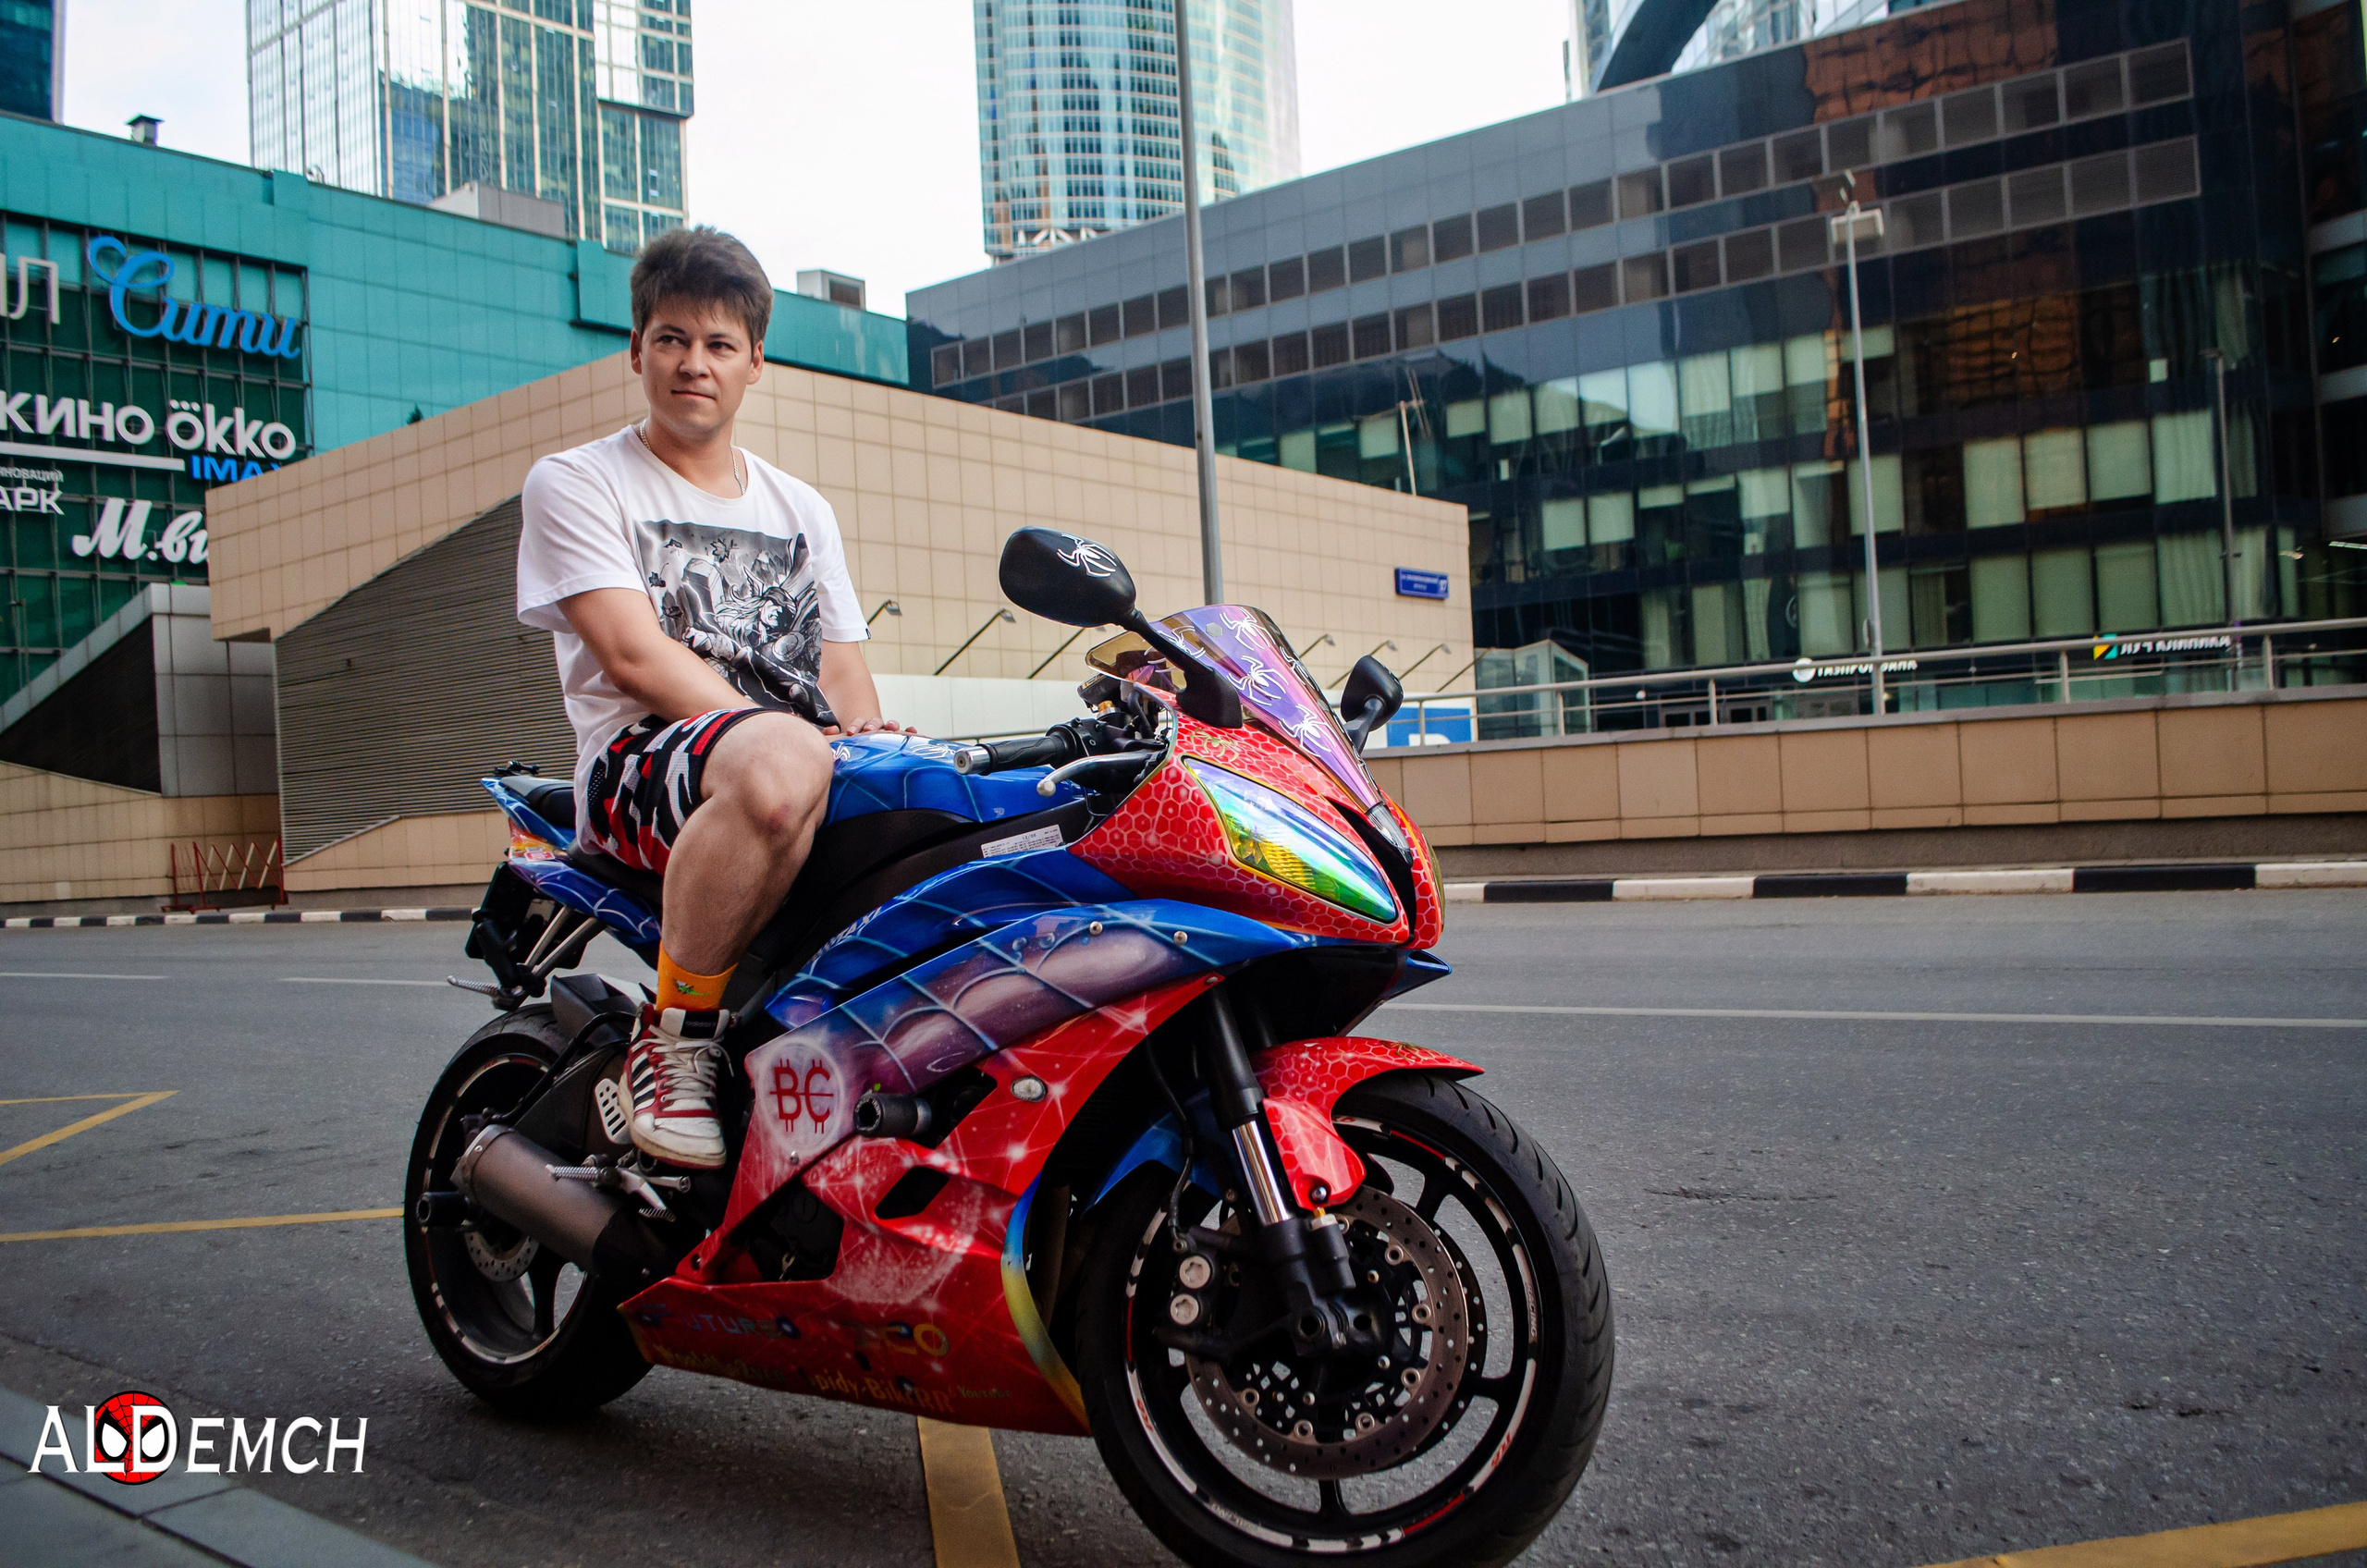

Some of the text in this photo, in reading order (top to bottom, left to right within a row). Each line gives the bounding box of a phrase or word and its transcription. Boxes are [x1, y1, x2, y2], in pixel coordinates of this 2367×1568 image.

[89, 236, 301, 359] Сити
[0, 390, 155, 446] КИНО
[190, 456, 281, 483] IMA
